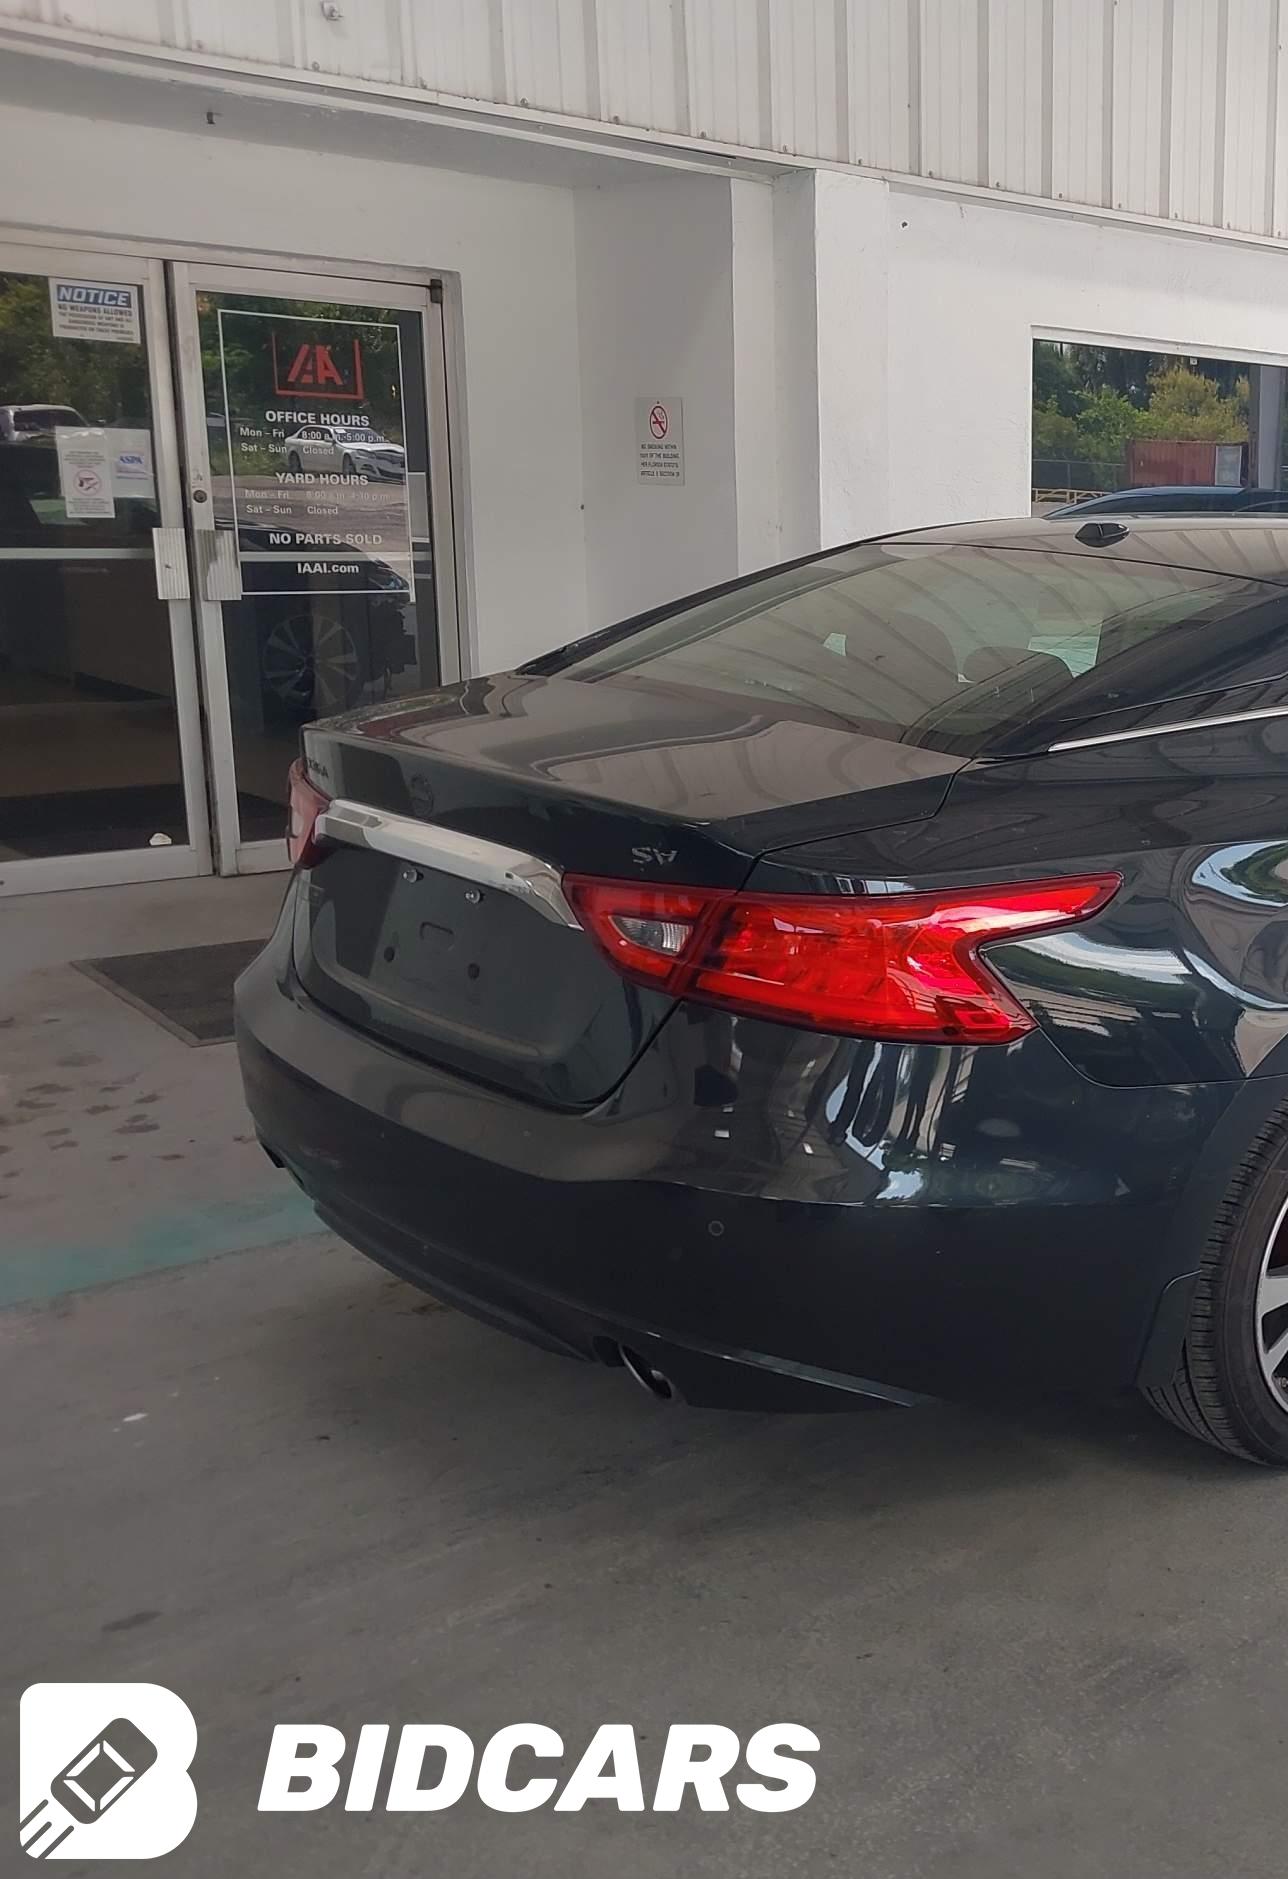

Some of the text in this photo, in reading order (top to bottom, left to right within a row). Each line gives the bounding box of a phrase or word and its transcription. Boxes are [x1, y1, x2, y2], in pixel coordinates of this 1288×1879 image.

[60, 287, 130, 306] NOTICE
[265, 410, 370, 427] OFFICE HOURS
[240, 427, 263, 437] Mon
[272, 428, 285, 438] Fri
[302, 431, 321, 440] 8:00
[241, 442, 258, 452] Sat
[268, 444, 288, 454] Sun
[303, 446, 335, 456] Closed
[276, 472, 369, 486] YARD HOURS
[245, 489, 267, 499] Mon
[278, 490, 289, 500] Fri
[246, 504, 263, 514] Sat
[273, 504, 292, 515] Sun
[307, 505, 339, 515] Closed
[270, 533, 383, 545] NO PARTS SOLD
[297, 562, 360, 574] IAAI.com
